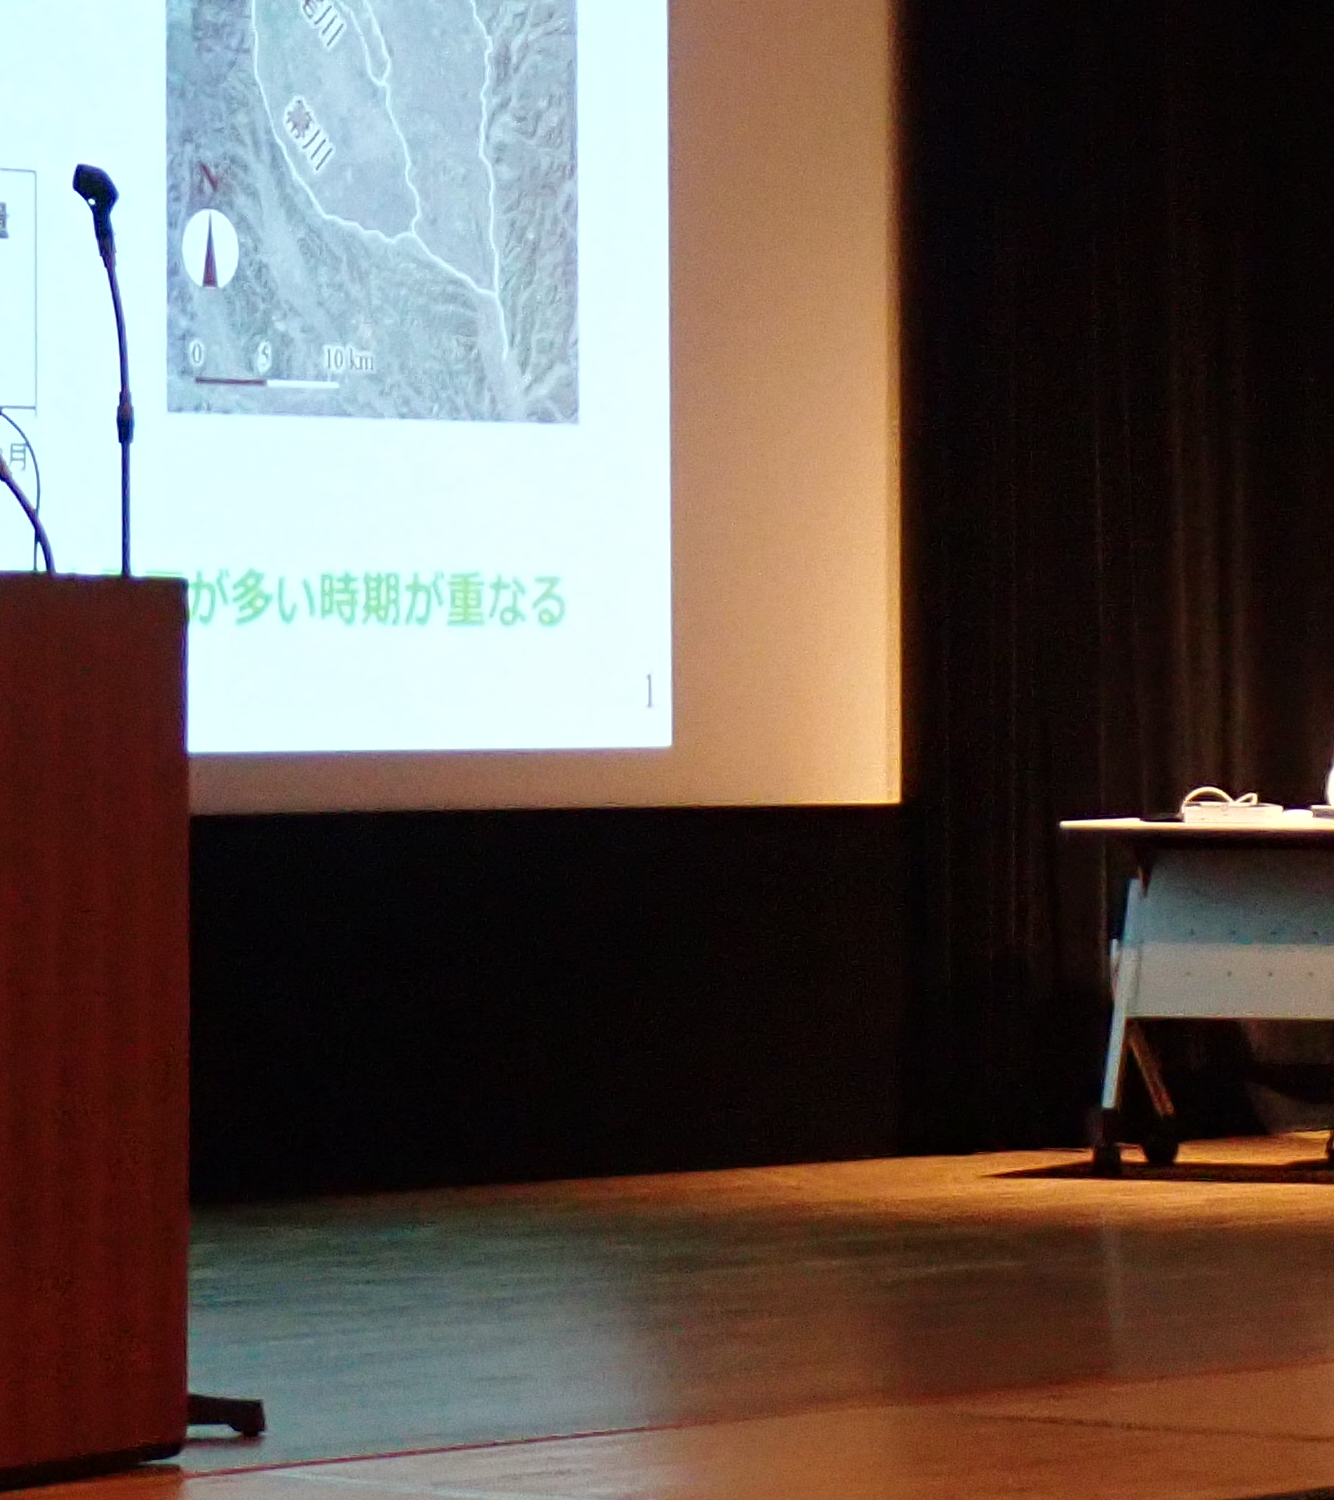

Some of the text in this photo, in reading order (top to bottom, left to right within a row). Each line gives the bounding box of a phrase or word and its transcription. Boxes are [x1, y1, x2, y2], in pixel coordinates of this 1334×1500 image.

[326, 348, 344, 370] 10
[349, 348, 374, 371] km
[645, 673, 655, 709] 1
